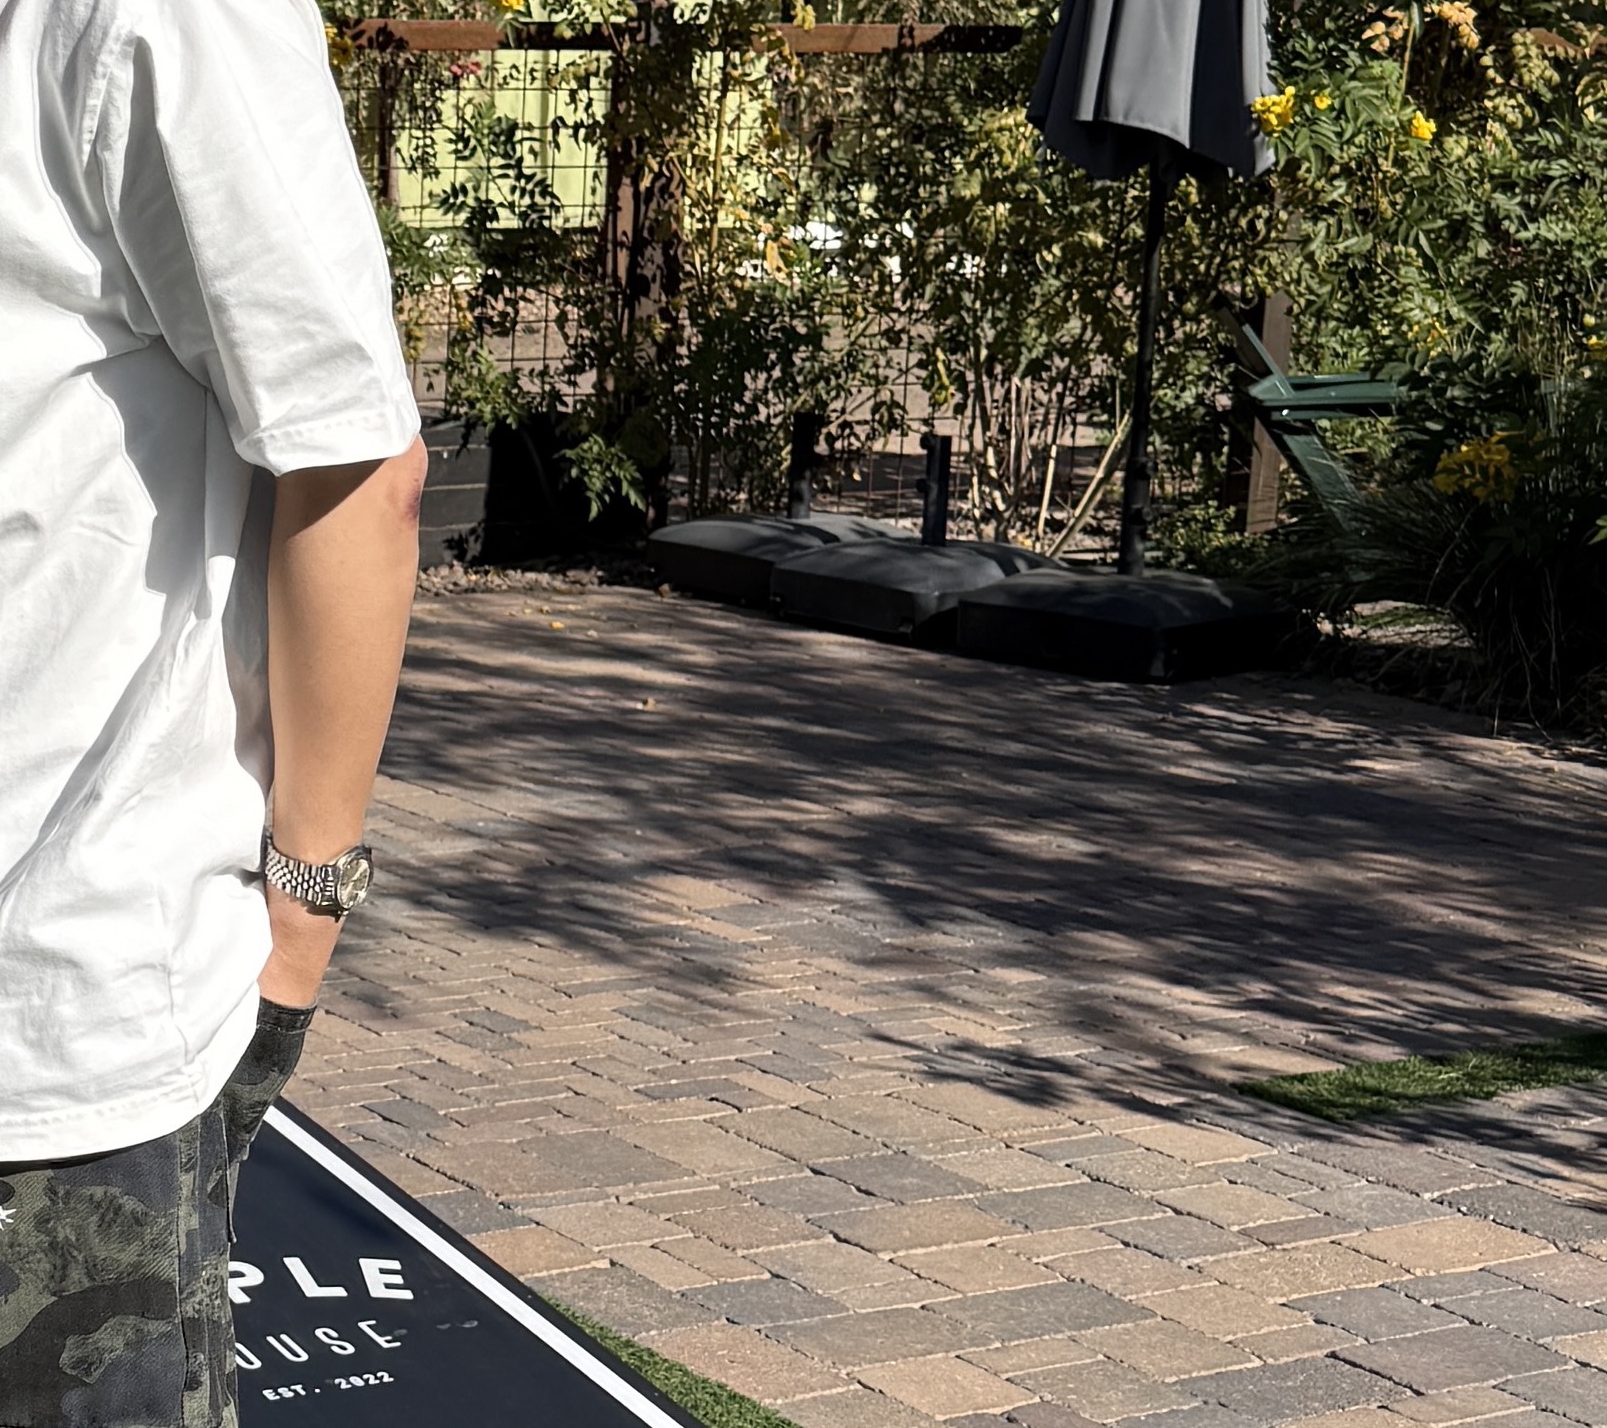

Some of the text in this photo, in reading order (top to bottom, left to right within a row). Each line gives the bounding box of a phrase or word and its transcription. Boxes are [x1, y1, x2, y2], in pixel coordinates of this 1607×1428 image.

[228, 1256, 414, 1304] PLE
[235, 1320, 401, 1370] OUSE
[262, 1372, 394, 1401] EST. 2022
